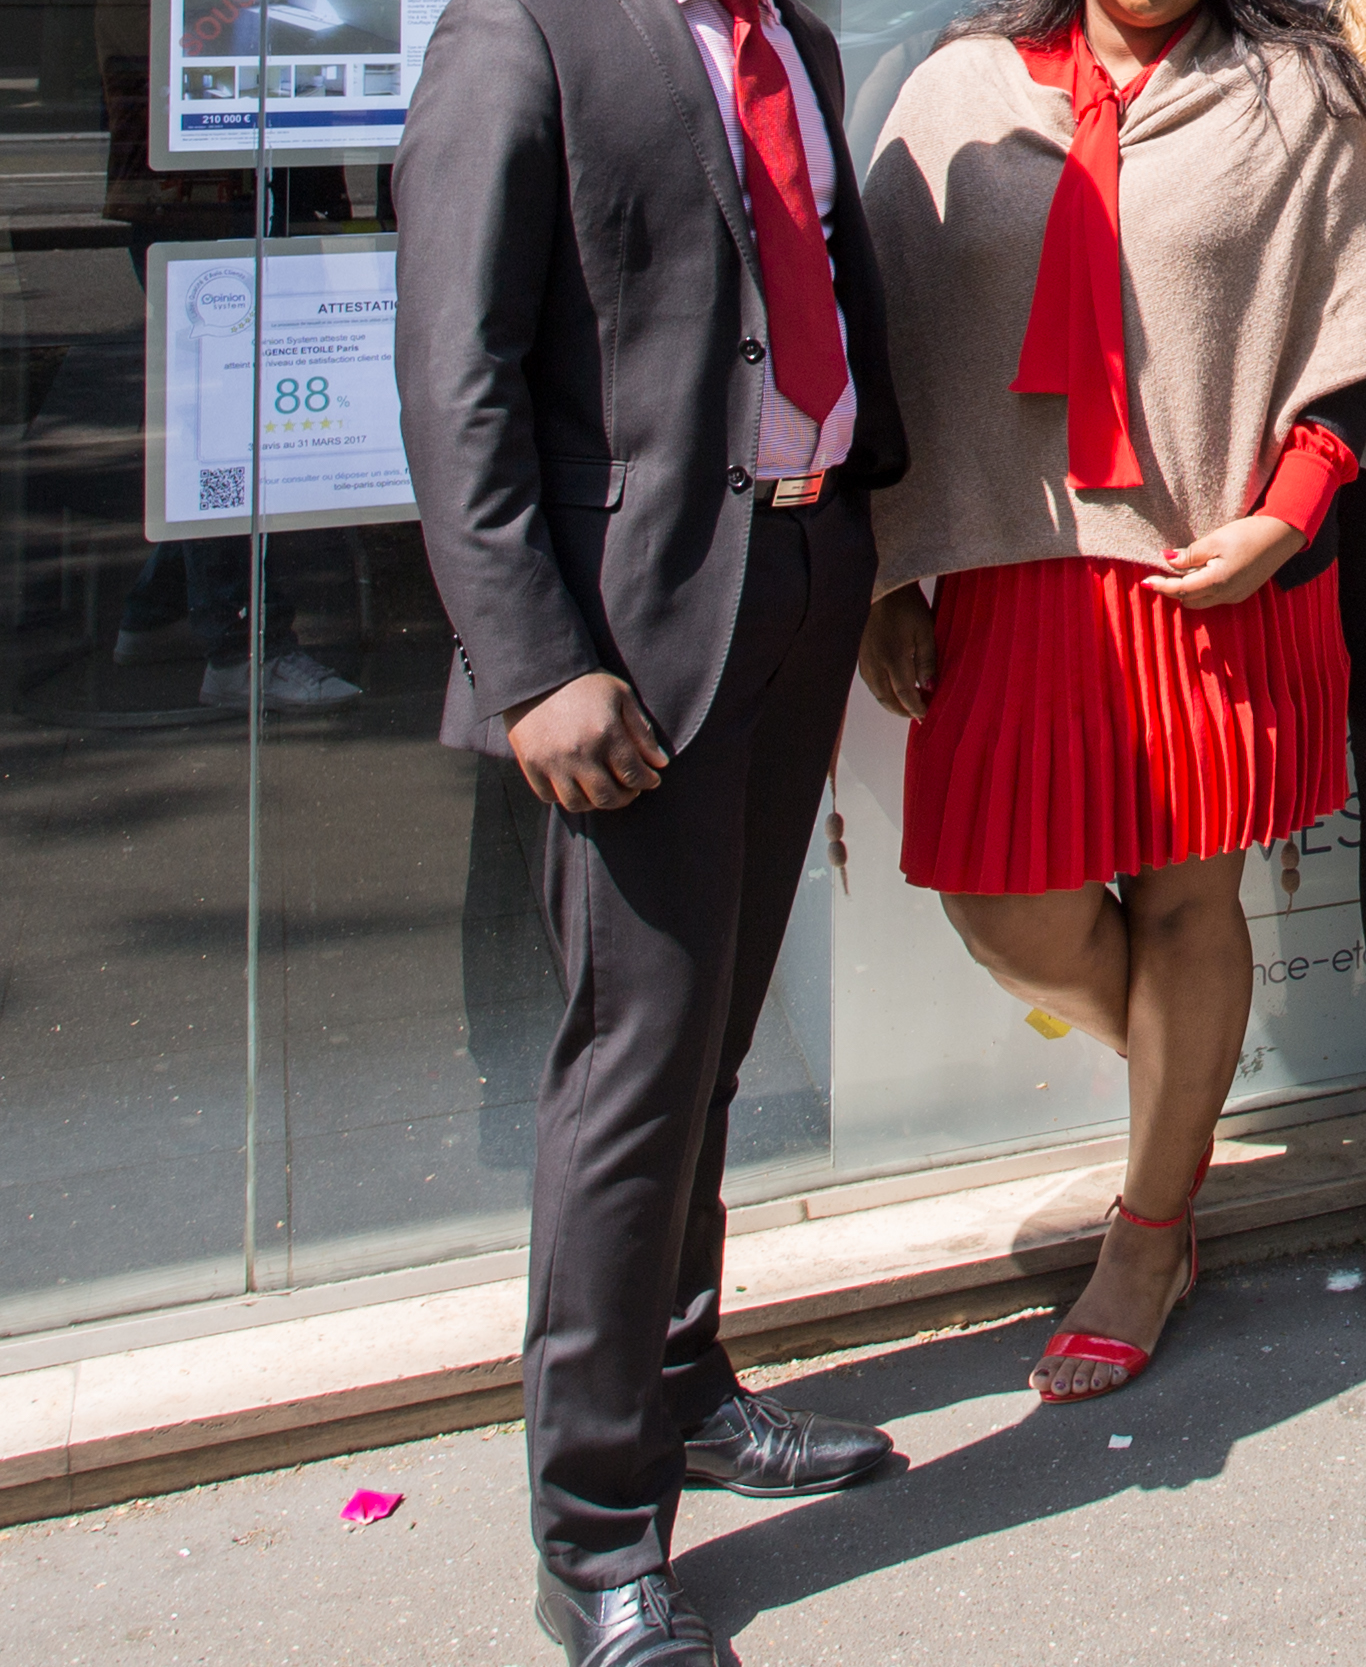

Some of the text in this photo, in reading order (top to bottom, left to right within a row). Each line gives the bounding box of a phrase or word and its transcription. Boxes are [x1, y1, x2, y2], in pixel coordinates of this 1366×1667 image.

[202, 113, 251, 125] 210 000 €
[201, 292, 246, 305] Opinion
[213, 302, 246, 310] system
[286, 335, 318, 346] System
[319, 335, 348, 344] atteste
[350, 334, 366, 343] que
[300, 345, 334, 355] ETOILE
[336, 344, 359, 353] Paris
[223, 353, 392, 370] atteint niveau de satisfaction client de
[274, 375, 351, 415] 88 %
[262, 441, 281, 451] avis
[283, 442, 296, 450] au
[297, 439, 309, 448] 31
[311, 436, 342, 447] MARS
[344, 435, 367, 444] 2017
[281, 474, 320, 484] consulter
[334, 471, 369, 482] déposer
